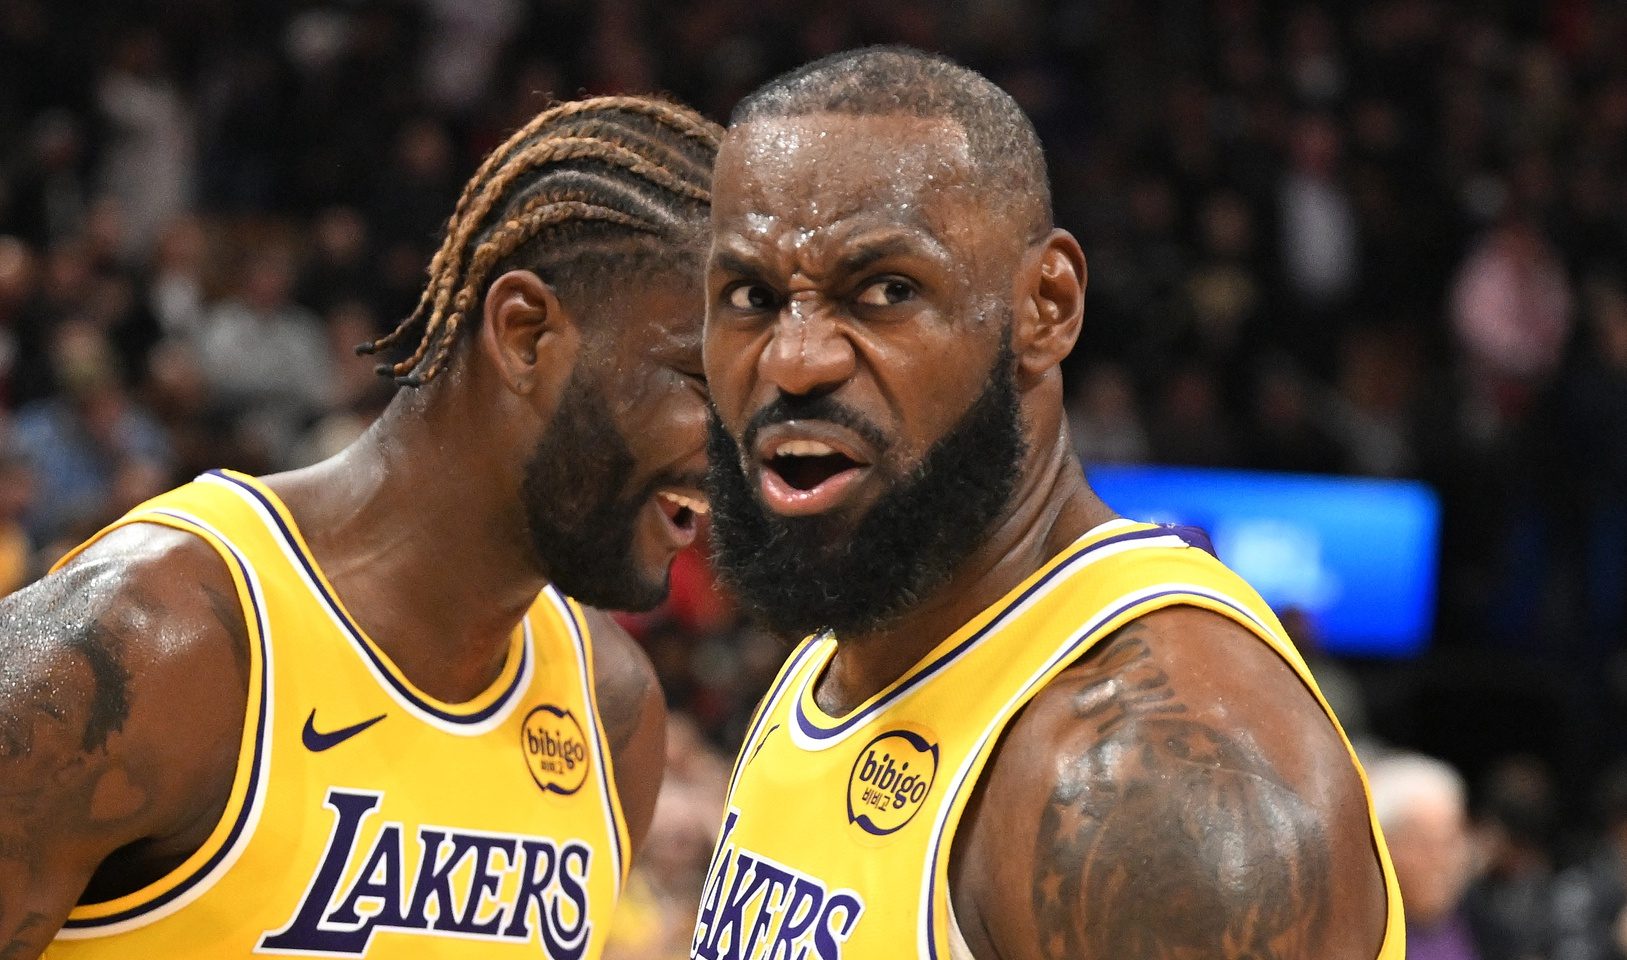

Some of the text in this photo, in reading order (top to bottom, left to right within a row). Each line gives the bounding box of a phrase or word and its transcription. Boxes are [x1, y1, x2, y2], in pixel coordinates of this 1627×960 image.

[527, 728, 584, 769] bibigo
[859, 750, 926, 809] bibigo
[861, 788, 891, 812] 비비고
[255, 788, 592, 960] LAKERS
